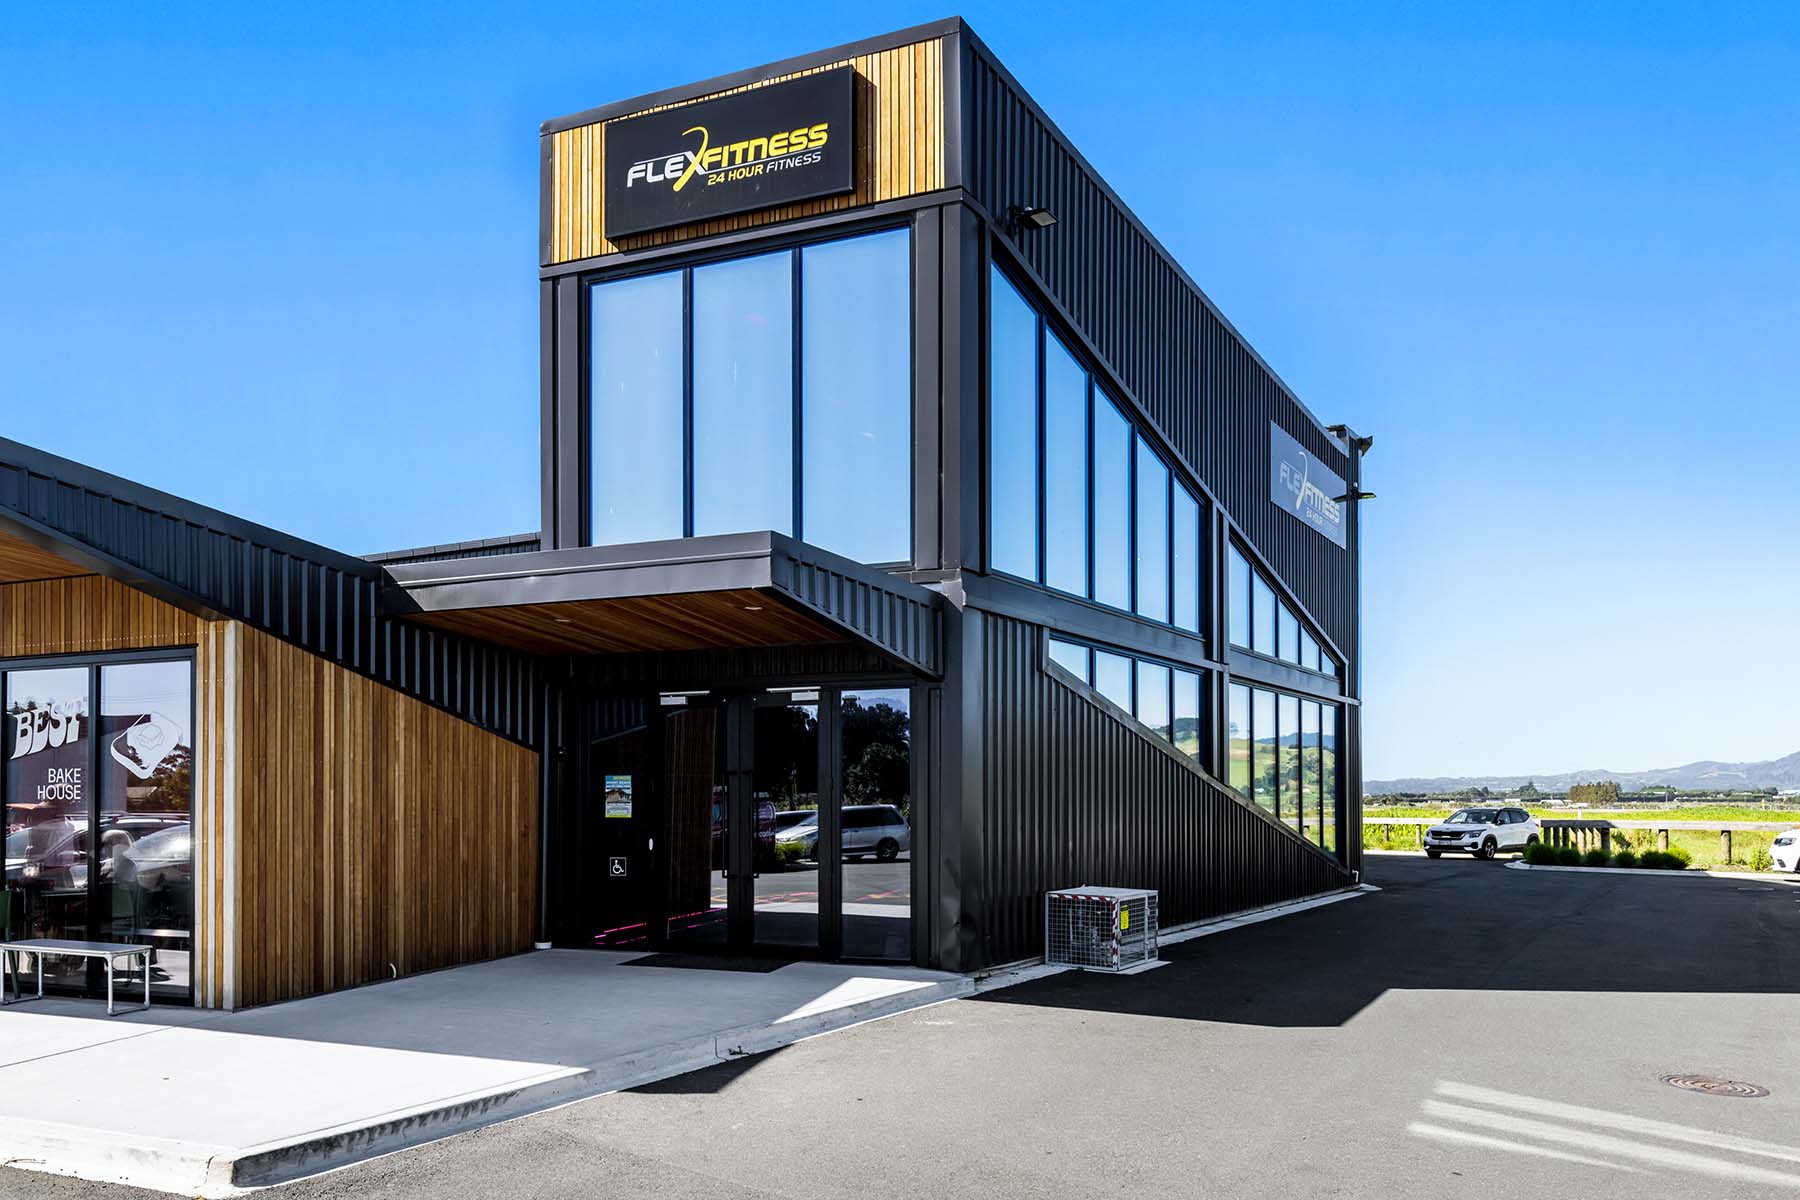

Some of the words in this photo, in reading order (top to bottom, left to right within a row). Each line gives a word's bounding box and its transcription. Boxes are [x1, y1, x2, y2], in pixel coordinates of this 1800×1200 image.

[707, 174, 725, 186] 24
[728, 164, 763, 182] HOUR
[766, 151, 822, 173] FITNESS
[10, 699, 82, 760] BEST
[48, 768, 82, 783] BAKE
[37, 784, 82, 801] HOUSE
